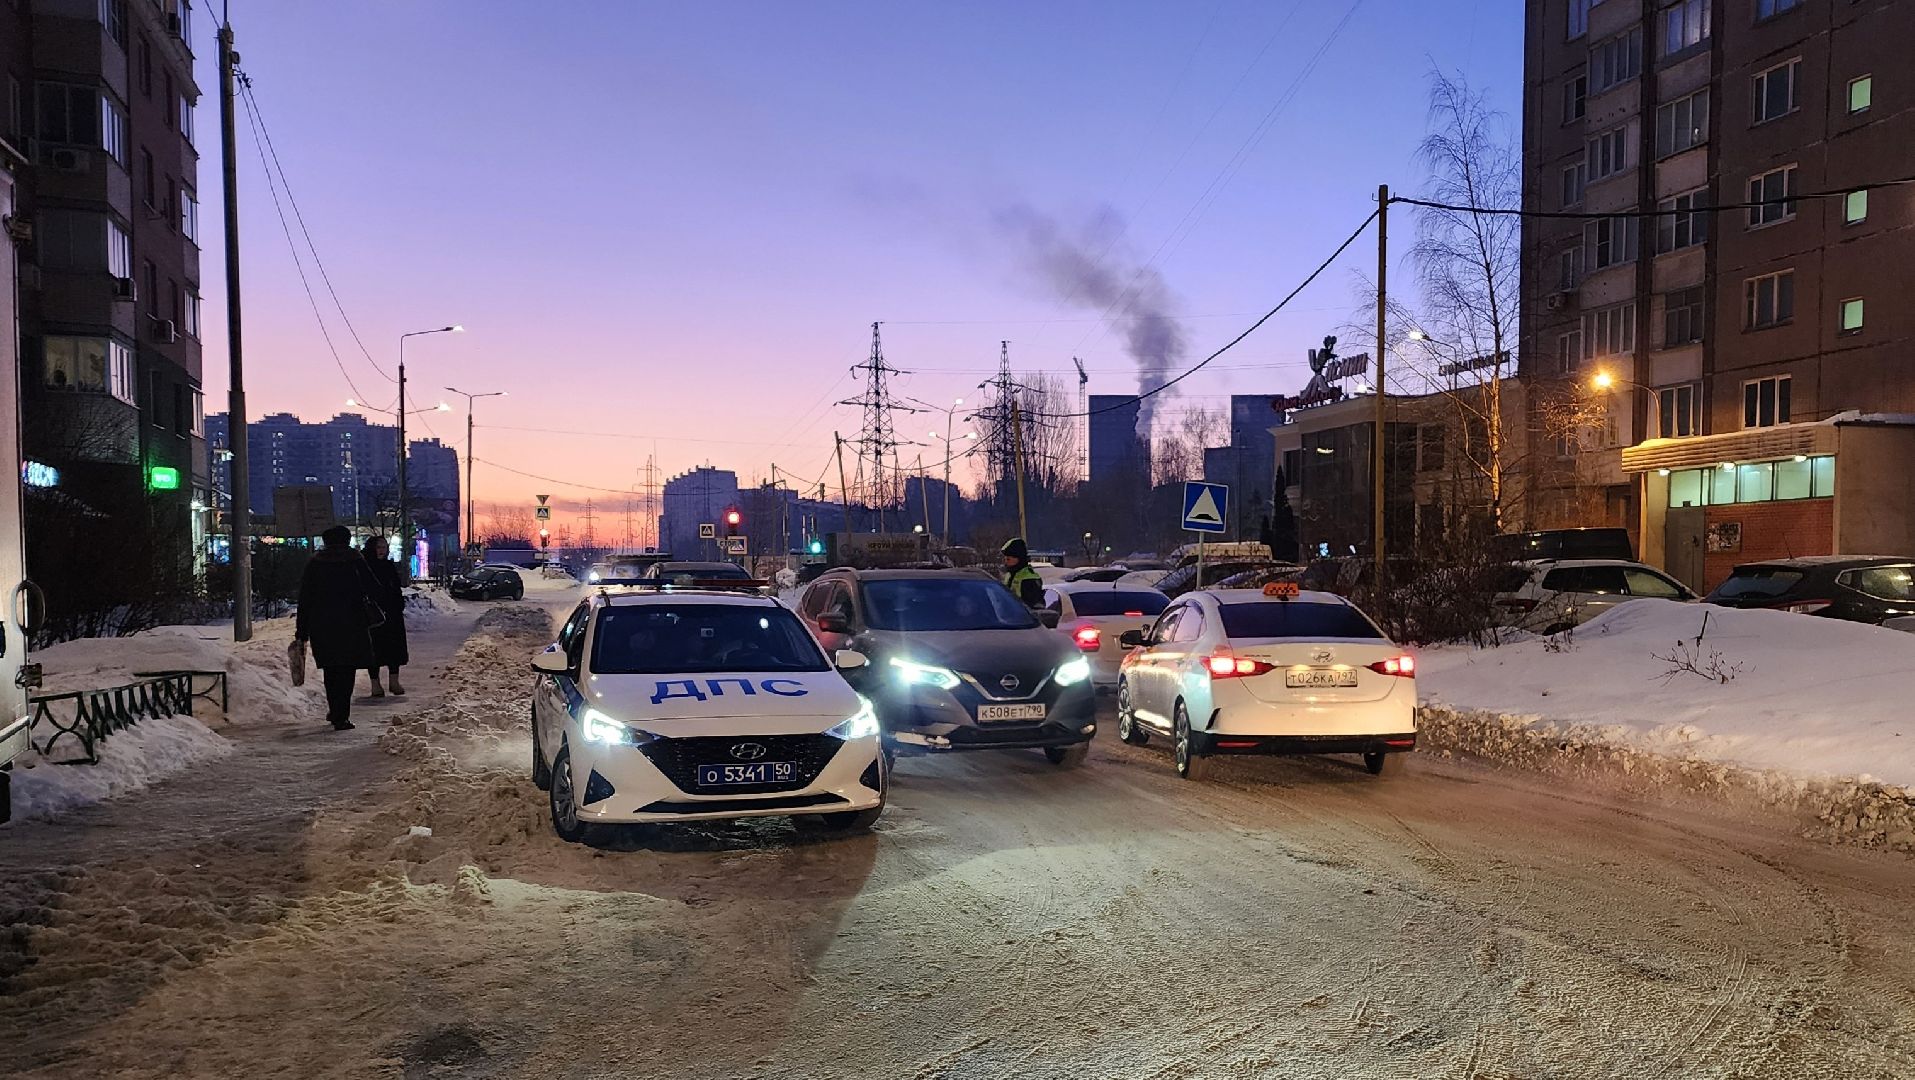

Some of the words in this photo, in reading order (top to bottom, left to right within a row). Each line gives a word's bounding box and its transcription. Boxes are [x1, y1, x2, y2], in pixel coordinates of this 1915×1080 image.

[650, 678, 809, 705] ДПС
[724, 765, 765, 782] 5341
[775, 763, 791, 775] 50
